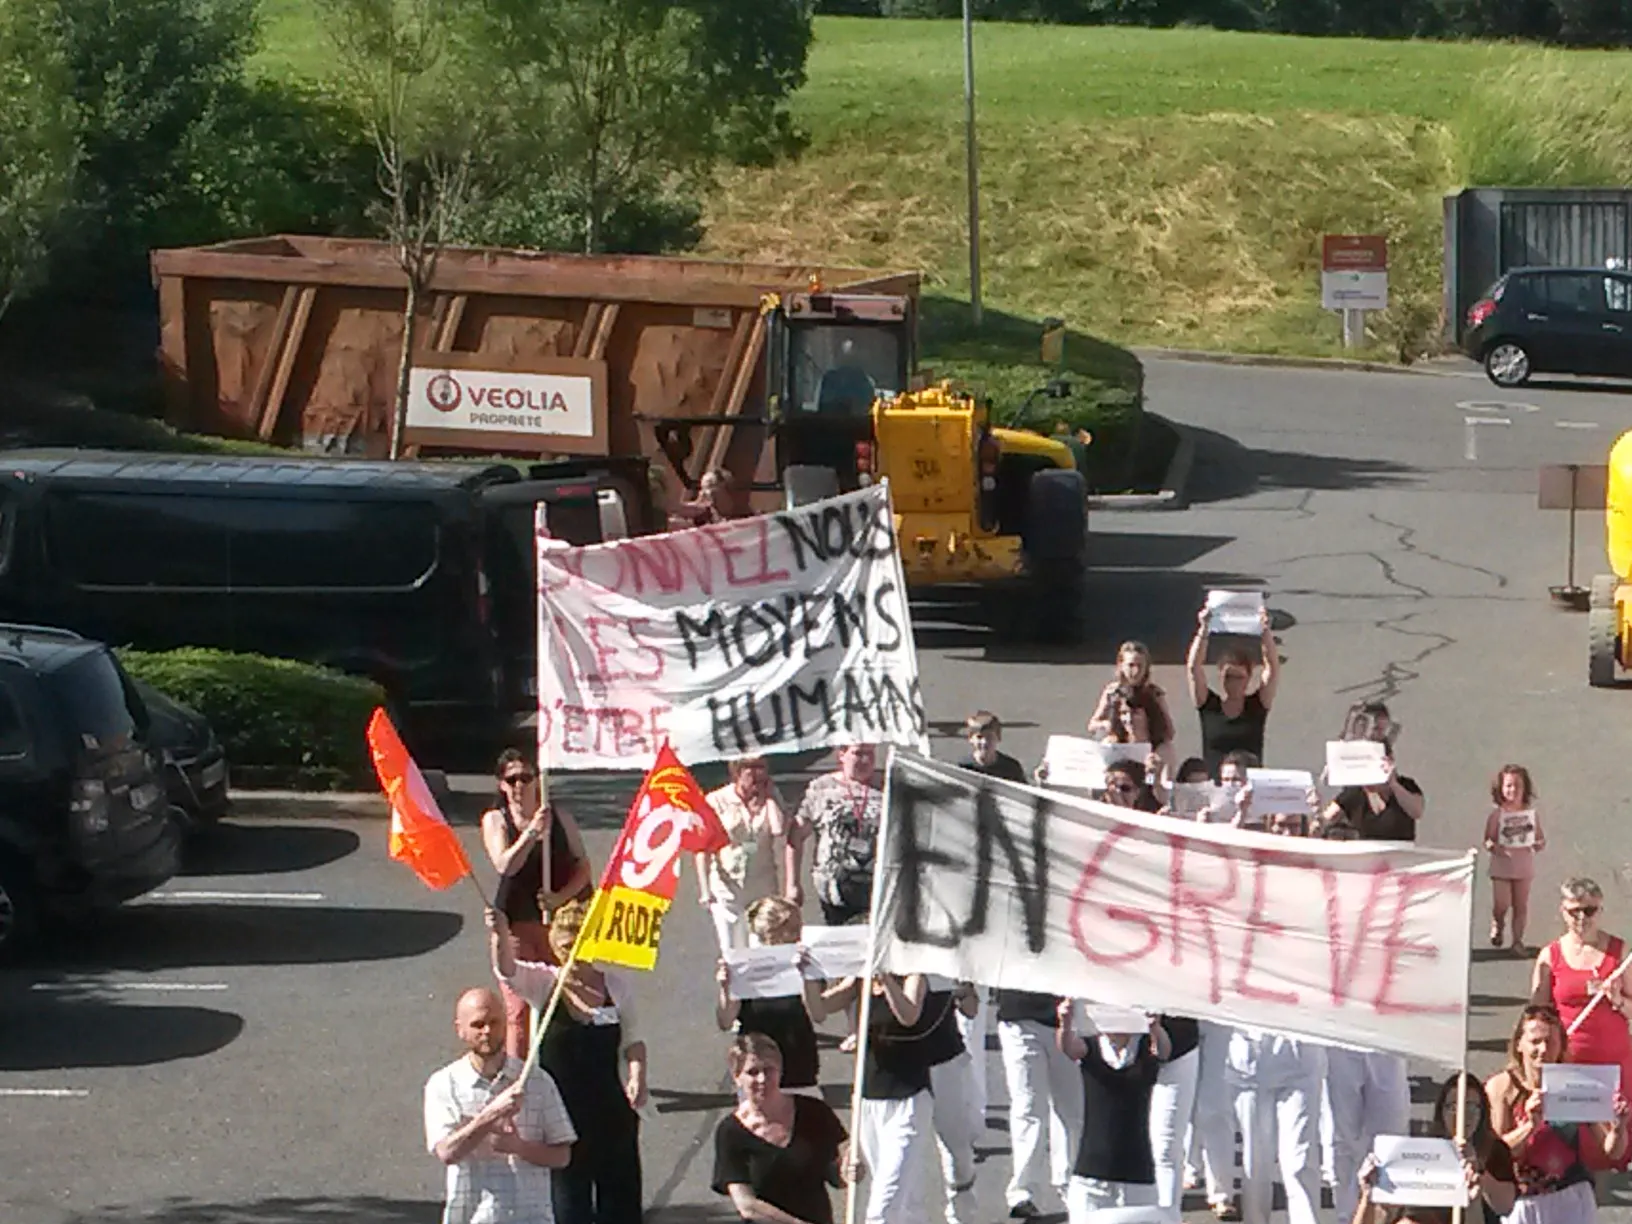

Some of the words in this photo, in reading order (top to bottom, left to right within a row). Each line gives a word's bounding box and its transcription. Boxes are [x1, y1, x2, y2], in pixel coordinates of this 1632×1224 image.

[468, 387, 568, 412] VEOLIA
[774, 501, 896, 571] NOUS
[675, 582, 902, 669] MOYENS
[896, 782, 1048, 954] EN
[1069, 824, 1466, 1014] GREVE
